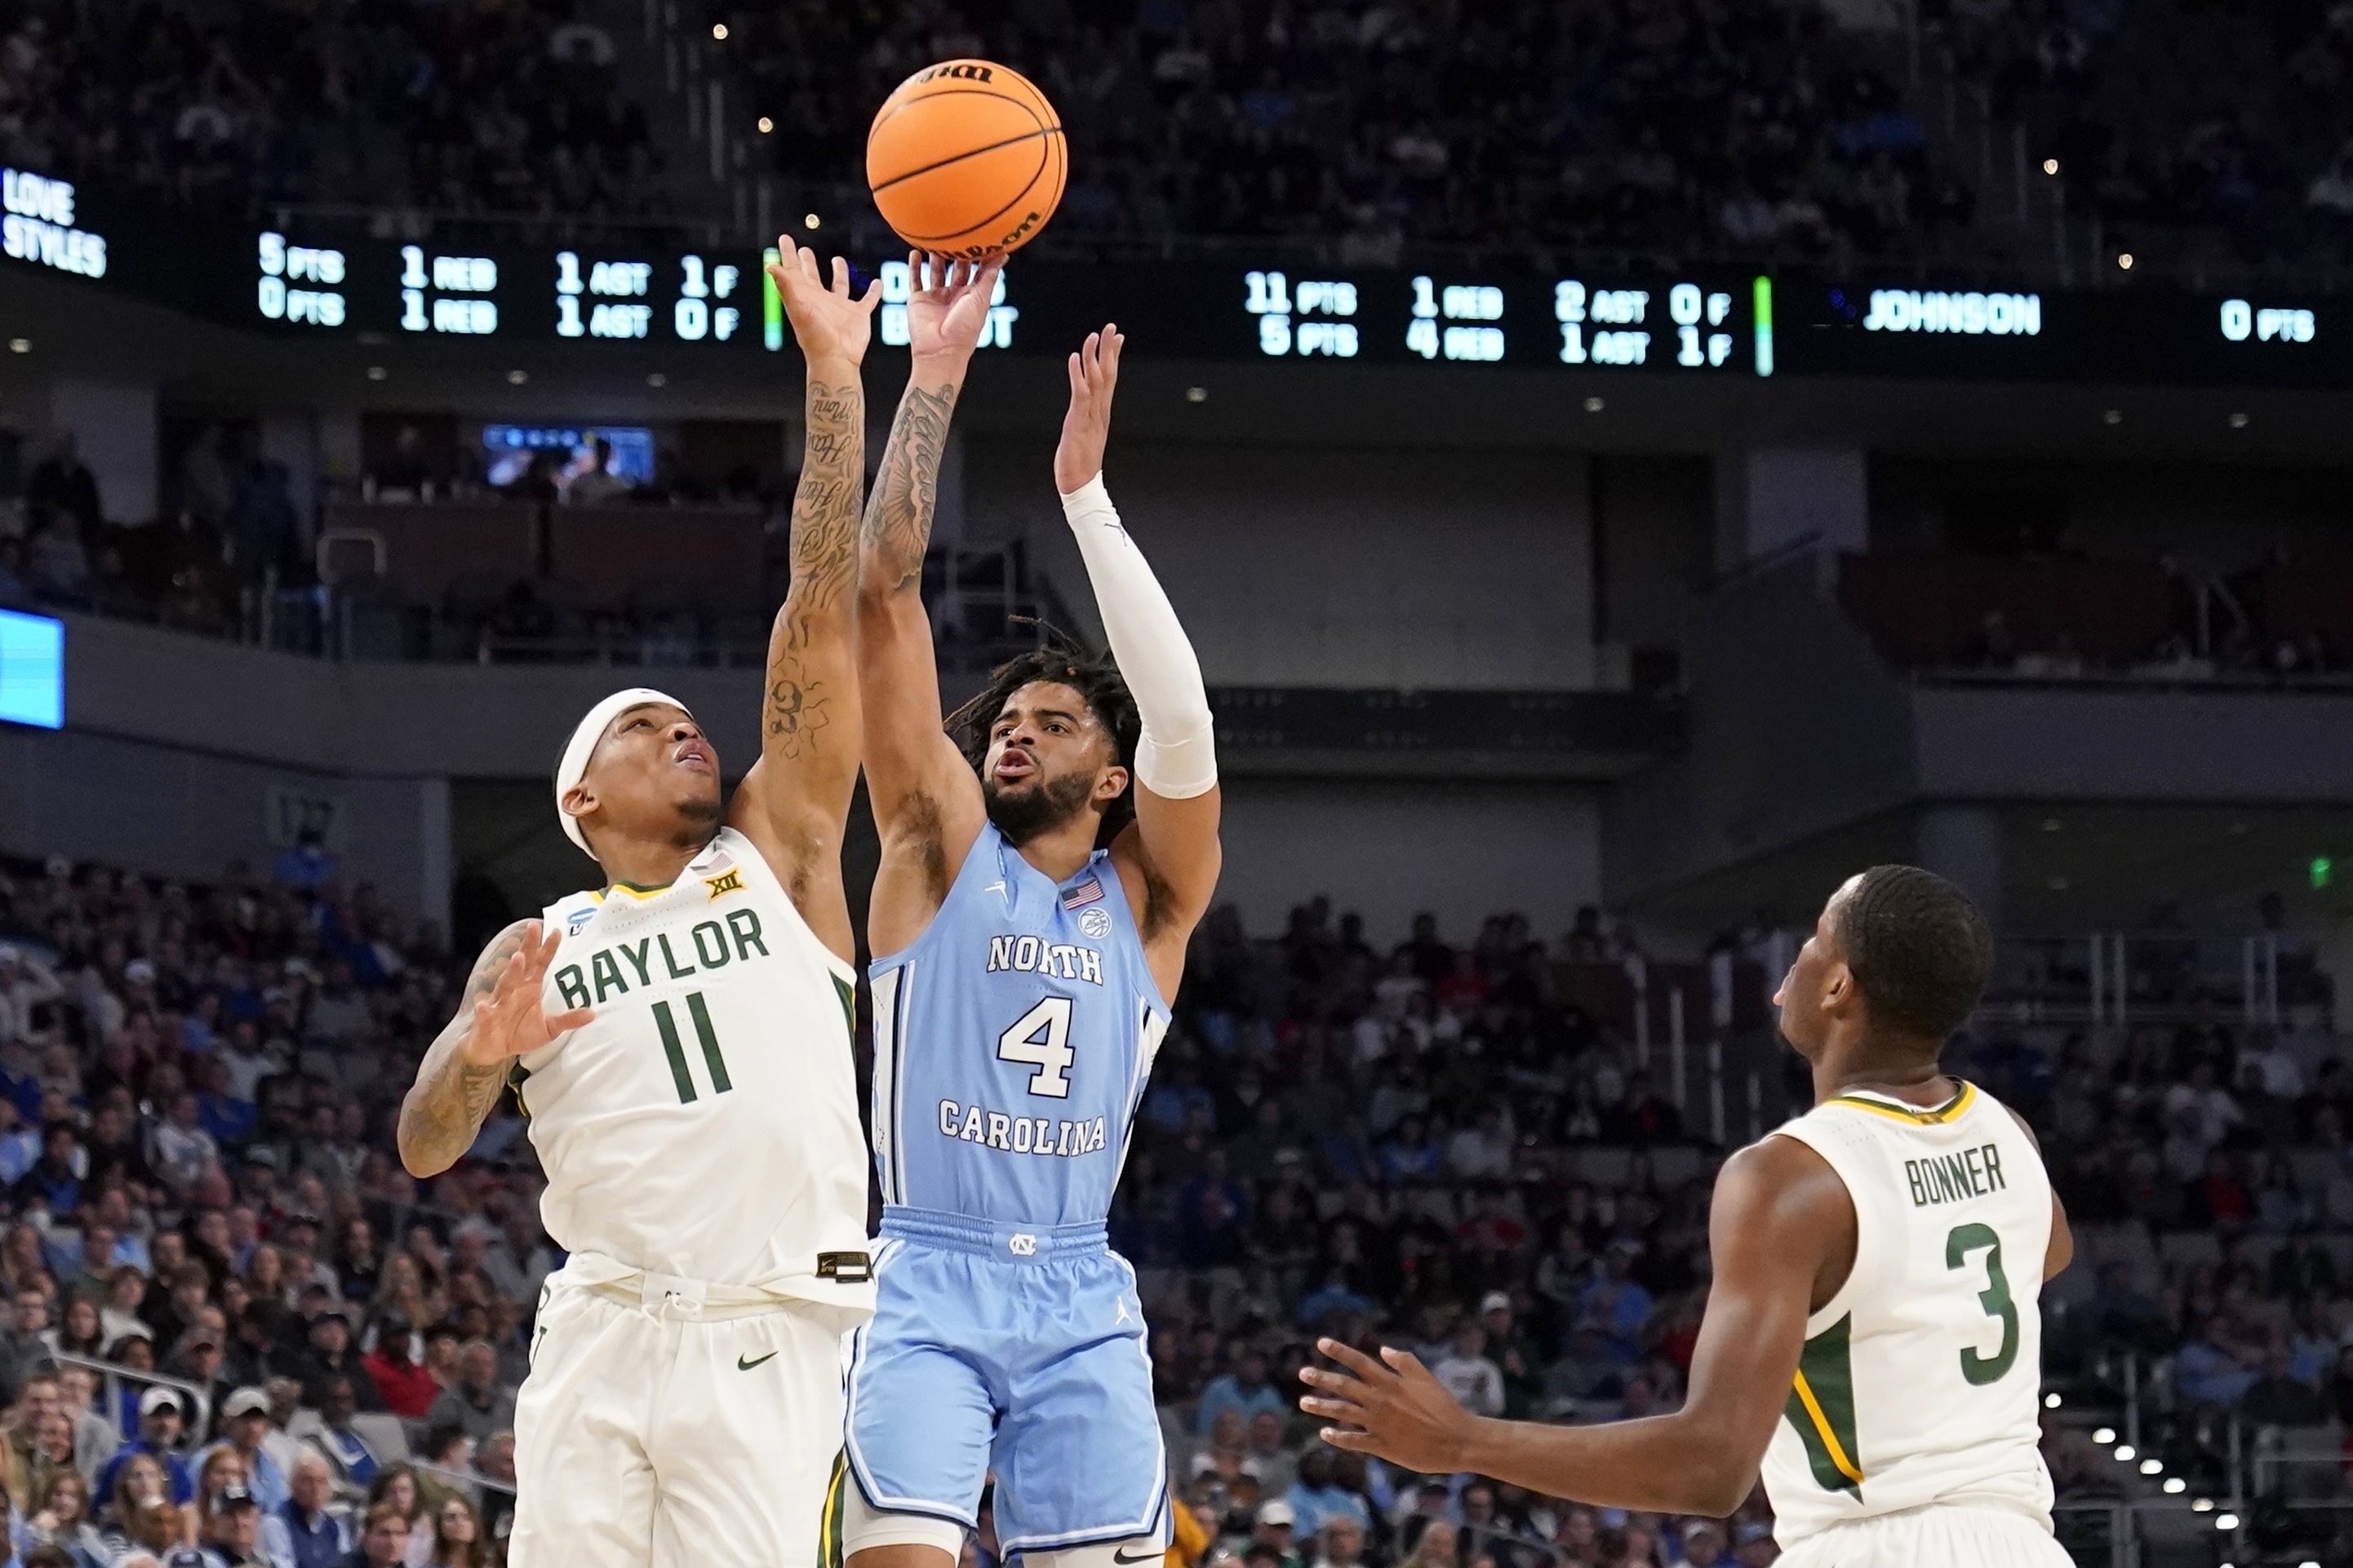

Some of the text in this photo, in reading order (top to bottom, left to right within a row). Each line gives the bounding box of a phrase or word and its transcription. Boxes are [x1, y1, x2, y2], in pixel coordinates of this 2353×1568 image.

[2, 167, 75, 227] LOVE
[2, 213, 108, 279] STYLES
[401, 245, 429, 288] 1
[556, 251, 585, 295] 1
[589, 261, 652, 296] AST
[681, 255, 709, 299] 1
[713, 264, 739, 299] F
[401, 288, 429, 331] 1
[556, 294, 585, 337] 1
[589, 304, 652, 339] AST
[714, 307, 739, 341] F
[1245, 271, 1293, 315] 11
[1412, 275, 1439, 318] 1
[1555, 280, 1587, 324] 2
[1590, 290, 1649, 324] AST
[1707, 292, 1732, 326] F
[1862, 289, 2041, 335] JOHNSON
[1405, 317, 1440, 360] 4
[1560, 322, 1587, 364] 1
[1591, 331, 1651, 365] AST
[1677, 325, 1705, 366] 1
[1707, 333, 1733, 367] F
[706, 870, 743, 899] XII
[554, 908, 770, 1011] BAYLOR
[987, 935, 1103, 986] NORTH
[650, 991, 733, 1104] 11
[997, 995, 1076, 1099] 4
[939, 1099, 1106, 1157] CAROLINA
[1904, 1144, 2007, 1208] BONNER
[1946, 1223, 2020, 1387] 3
